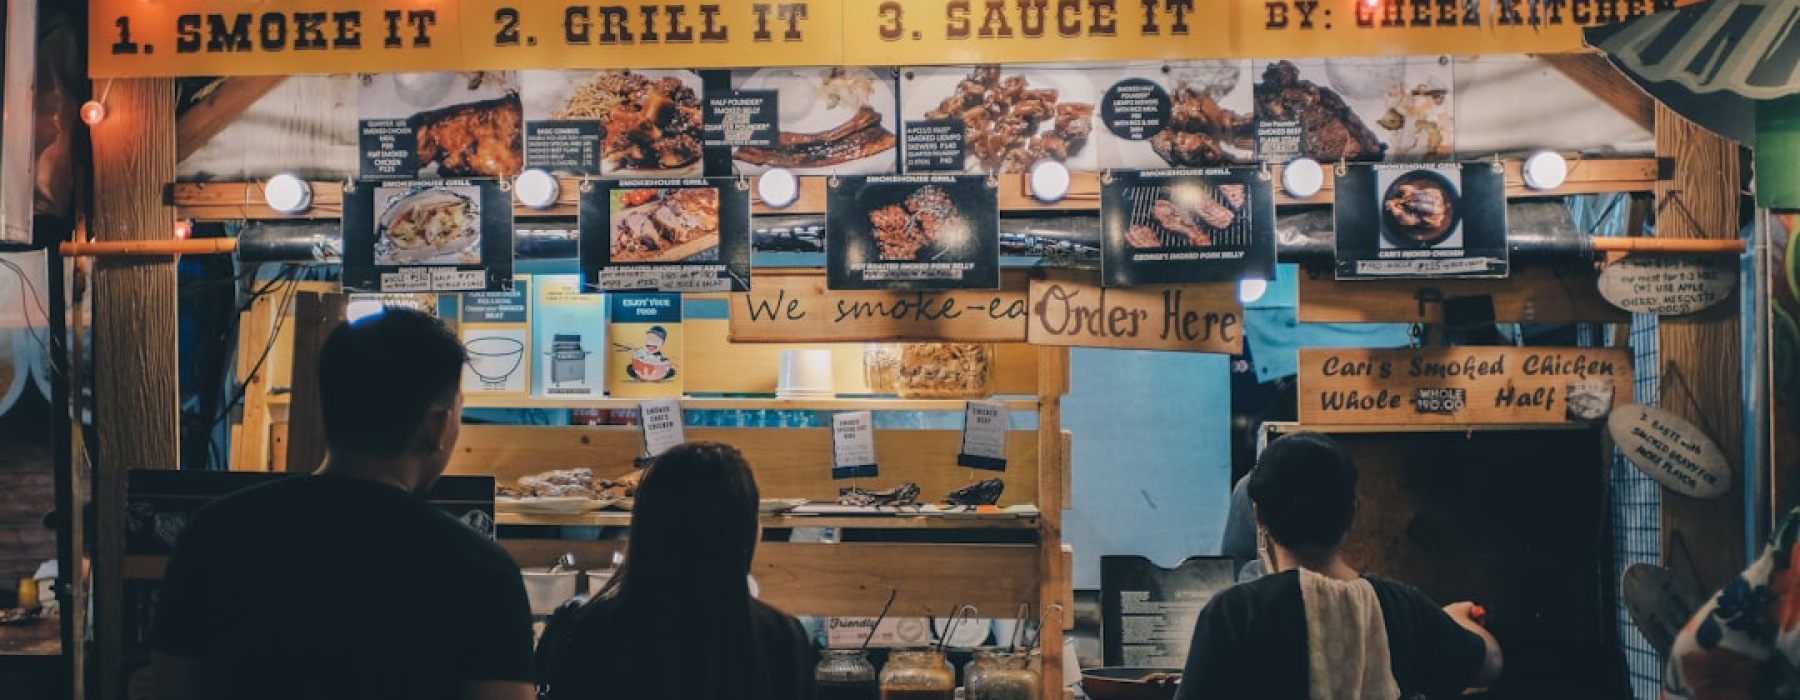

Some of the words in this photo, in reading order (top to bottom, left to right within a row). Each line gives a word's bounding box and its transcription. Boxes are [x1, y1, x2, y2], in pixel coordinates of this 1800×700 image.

[494, 7, 537, 46] 2.
[564, 4, 728, 45] GRILL
[752, 2, 808, 42] IT
[878, 1, 922, 41] 3.
[946, 0, 1117, 39] SAUCE
[1140, 0, 1195, 35] IT
[1265, 1, 1333, 30] BY:
[112, 16, 154, 55] 1.
[177, 11, 361, 53] SMOKE
[385, 10, 436, 48] IT
[1140, 170, 1204, 178] SMOKEHOUSE
[1169, 252, 1199, 260] SMOKED
[1220, 251, 1245, 259] BELLY
[622, 298, 647, 307] ENJOY
[649, 298, 670, 307] YOUR
[746, 289, 806, 323] We
[1035, 285, 1148, 337] Order
[1160, 289, 1236, 342] Here
[1322, 356, 1392, 378] Cari's
[1410, 354, 1504, 380] Smoked
[1522, 354, 1614, 380] Chicken
[1321, 389, 1401, 411] Whole
[1495, 386, 1556, 411] Half
[1417, 399, 1464, 410] 190.00
[1419, 389, 1463, 399] WHOLE
[829, 617, 878, 630] Friendly
